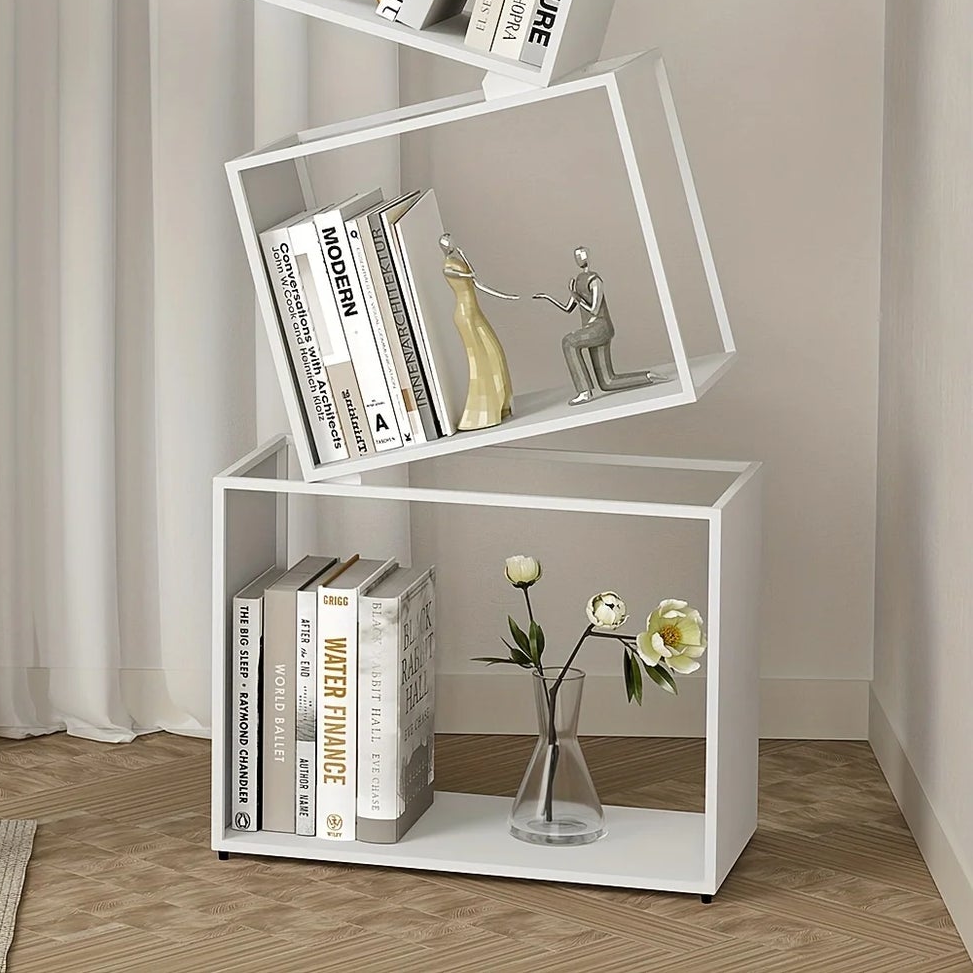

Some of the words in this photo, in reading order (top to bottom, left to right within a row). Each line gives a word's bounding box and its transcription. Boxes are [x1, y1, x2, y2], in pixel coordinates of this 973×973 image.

[476, 18, 487, 31] EL
[322, 227, 358, 317] MODERN
[272, 246, 283, 273] John
[292, 321, 305, 344] and
[300, 347, 317, 392] Heinrich
[313, 395, 325, 421] Klotz
[372, 227, 427, 407] INNENARCHITEKTUR
[280, 243, 312, 342] Conversations
[308, 346, 322, 375] with
[317, 380, 341, 449] Architects
[375, 413, 389, 432] A
[239, 605, 248, 624] THE
[323, 595, 349, 606] GRIGG
[239, 628, 248, 646] BIG
[300, 619, 309, 643] AFTER
[239, 649, 248, 678] SLEEP
[300, 661, 309, 677] END
[323, 637, 346, 698] WATER
[370, 651, 381, 701] ABBIT
[274, 664, 285, 710] WORLD
[405, 670, 429, 715] HALL
[238, 692, 248, 745] RAYMOND
[370, 707, 381, 742] HALL
[274, 716, 285, 762] BALLET
[323, 705, 345, 785] FINANCE
[238, 749, 248, 803] CHANDLER
[299, 758, 308, 789] AUTHOR
[371, 753, 379, 773] EVE
[299, 794, 308, 816] NAME
[370, 777, 379, 811] CHASE
